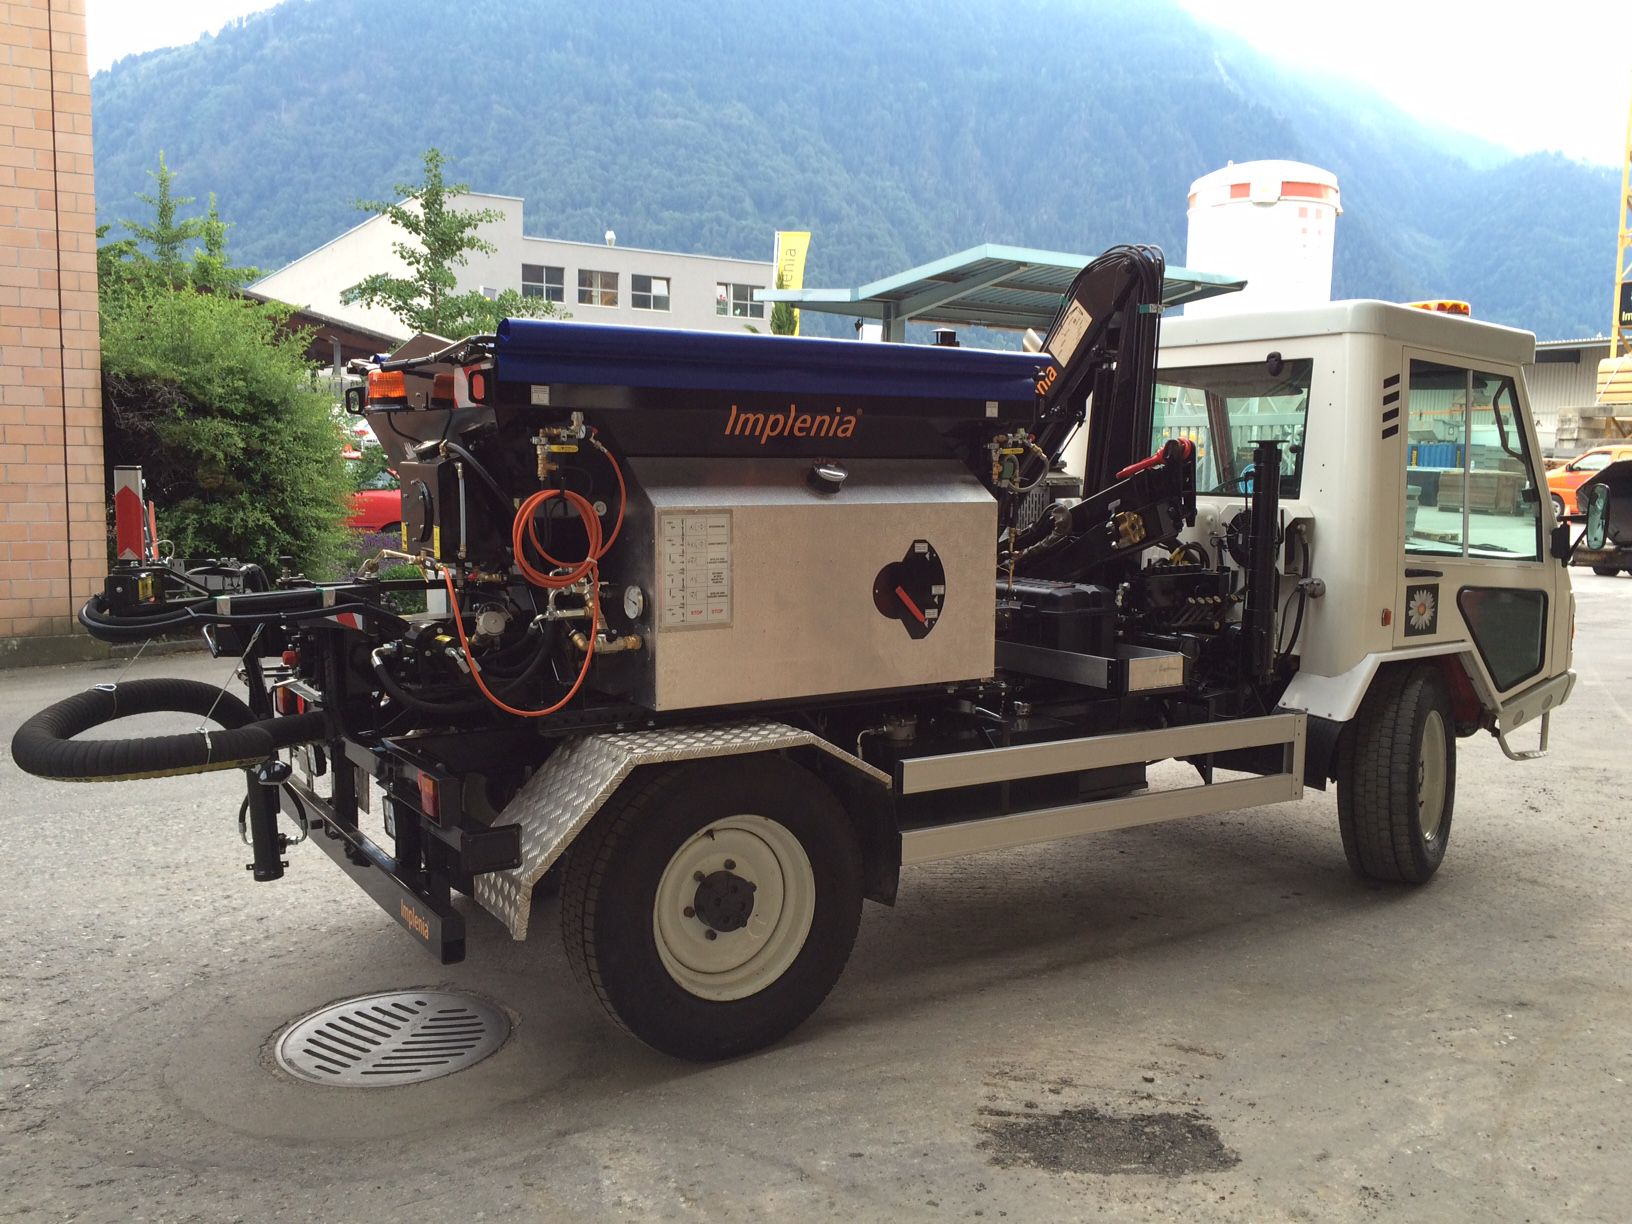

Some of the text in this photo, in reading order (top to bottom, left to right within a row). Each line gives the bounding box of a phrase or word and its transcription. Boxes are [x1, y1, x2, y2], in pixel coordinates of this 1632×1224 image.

[1035, 366, 1057, 395] nia
[723, 403, 858, 445] Implenia
[400, 898, 429, 941] Implenia
